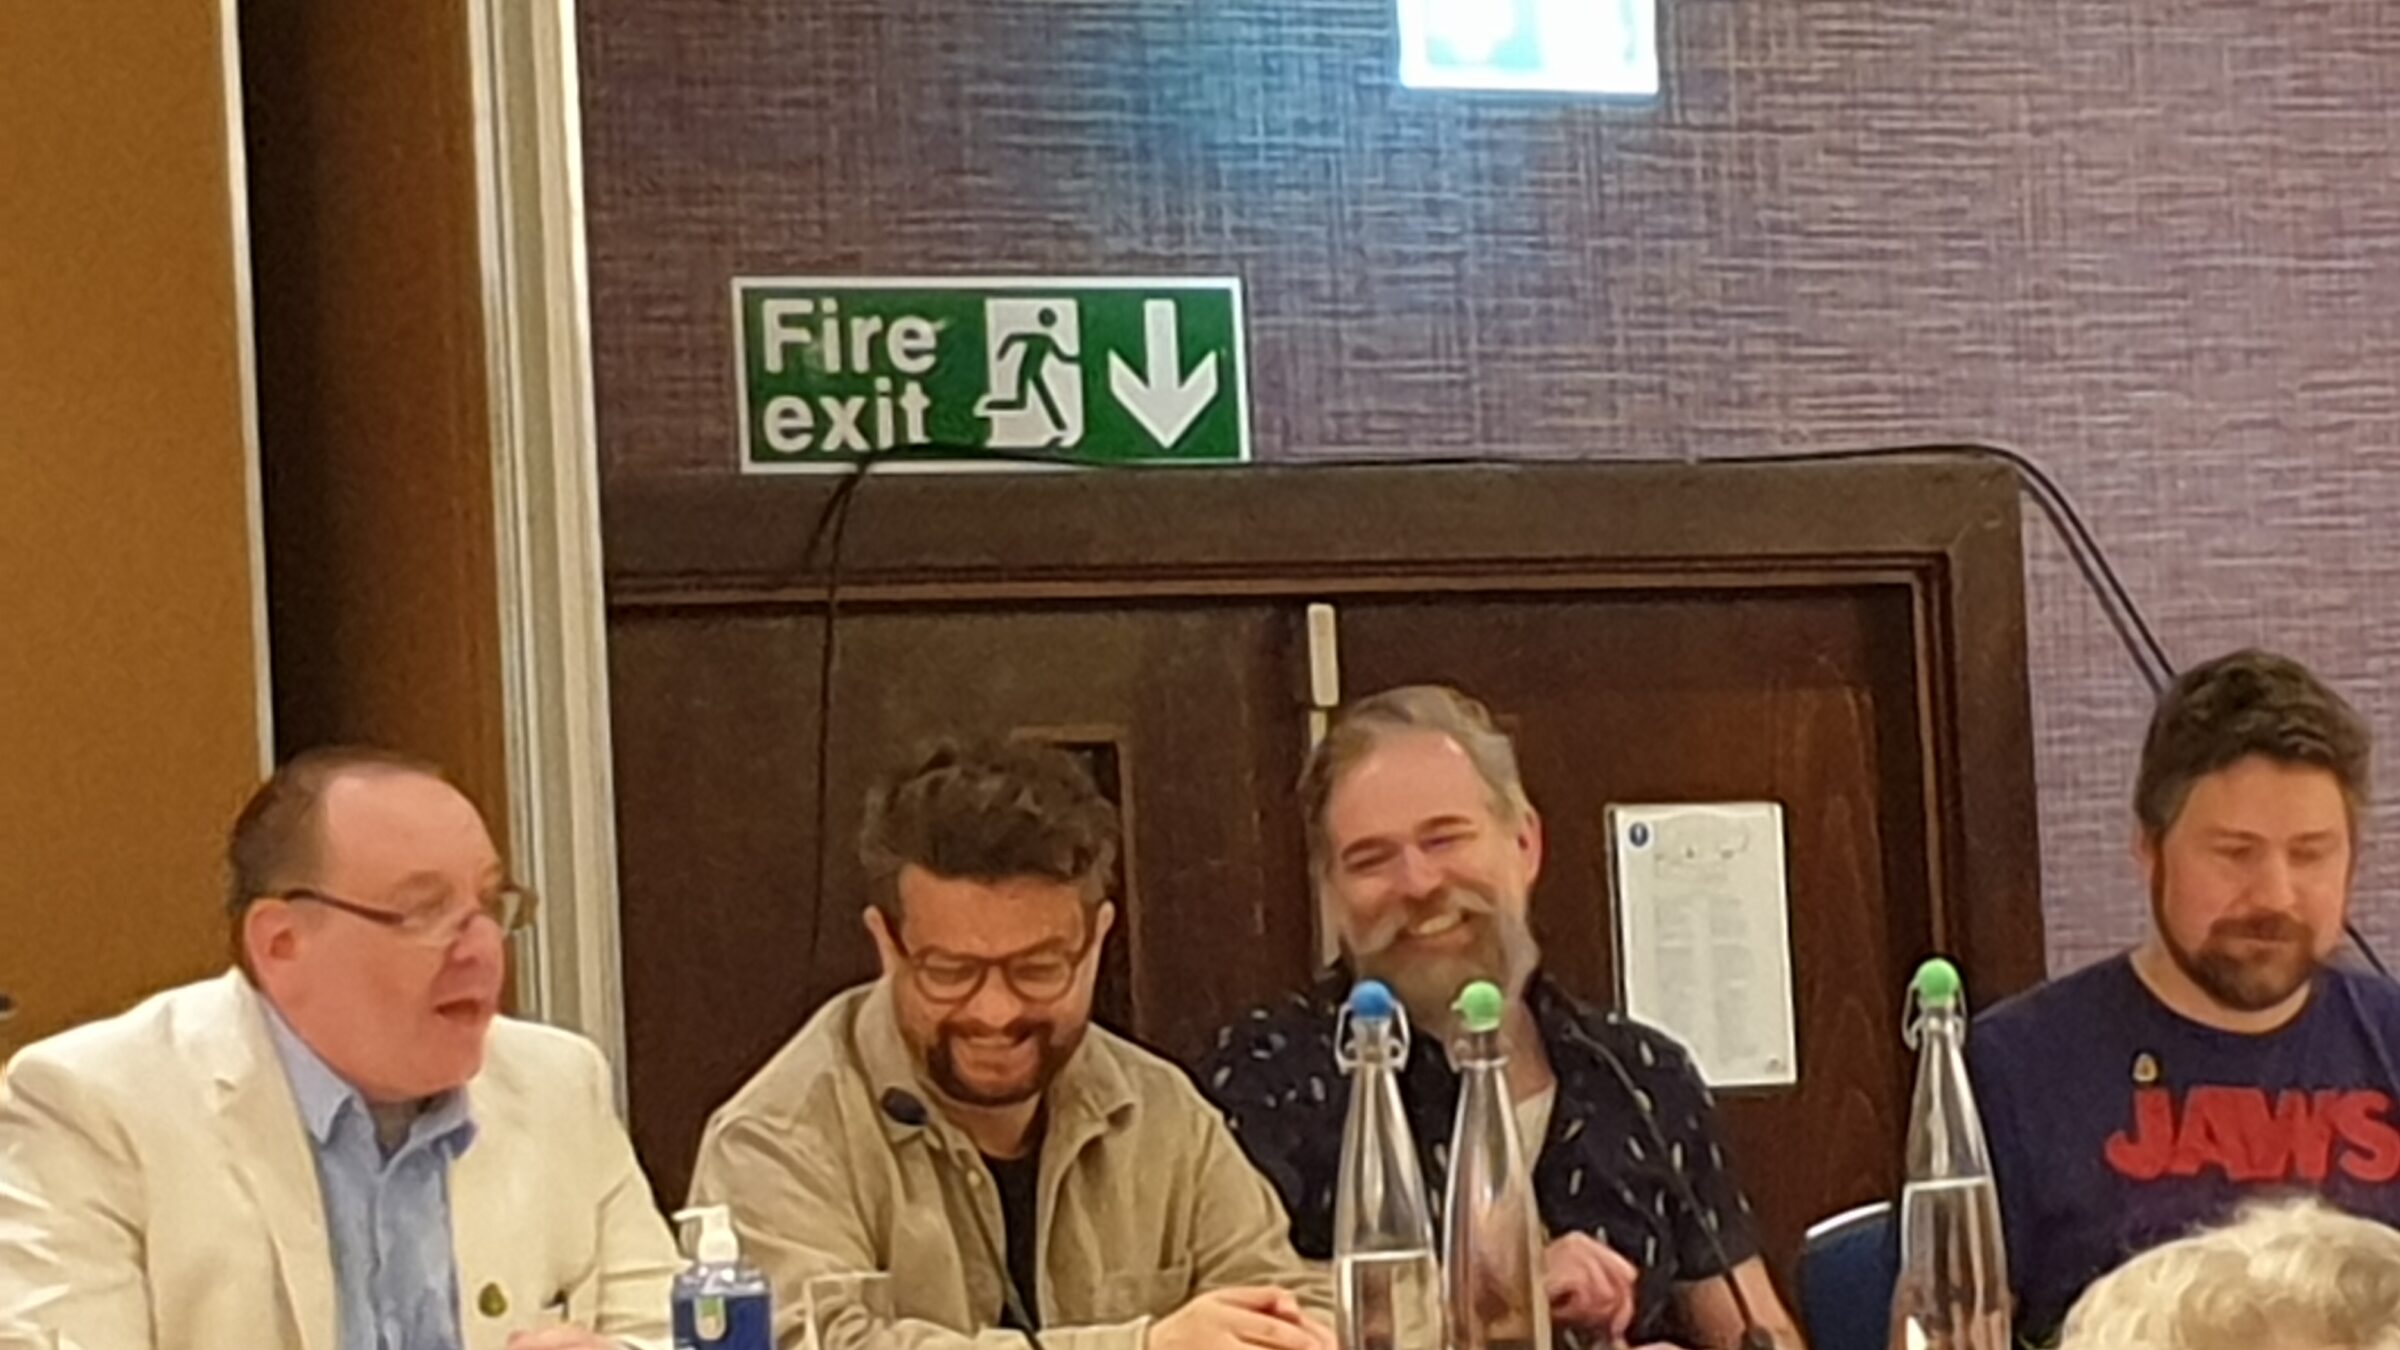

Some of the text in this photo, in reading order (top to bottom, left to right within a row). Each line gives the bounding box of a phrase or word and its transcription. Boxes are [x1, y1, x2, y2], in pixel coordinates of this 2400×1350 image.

[762, 297, 938, 374] Fire
[763, 376, 931, 452] exit
[2105, 1084, 2400, 1181] JAWS
